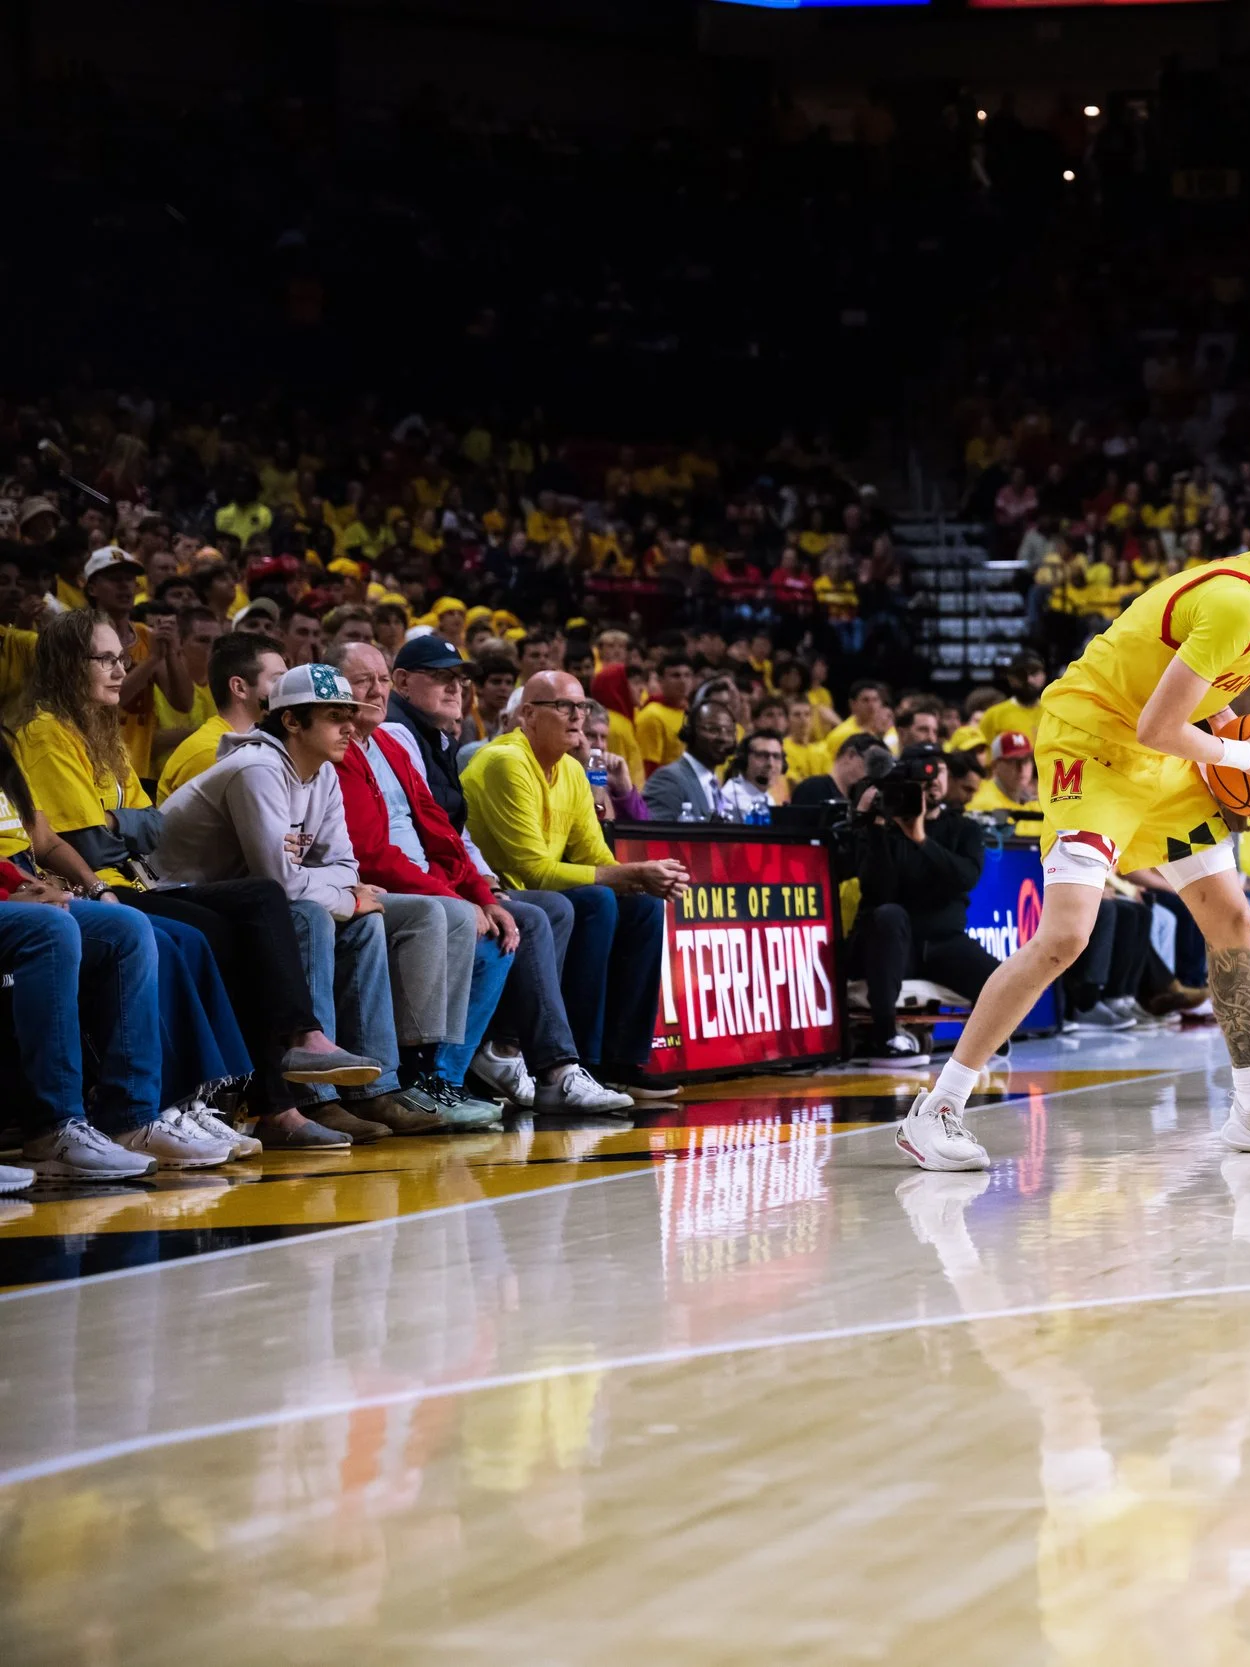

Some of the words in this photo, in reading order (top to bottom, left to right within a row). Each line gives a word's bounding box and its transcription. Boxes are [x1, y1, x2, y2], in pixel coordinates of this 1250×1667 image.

[1051, 758, 1087, 797] M
[682, 886, 737, 918] HOME
[748, 886, 771, 918] OF
[781, 885, 818, 917] THE
[675, 925, 833, 1040] TERRAPINS
